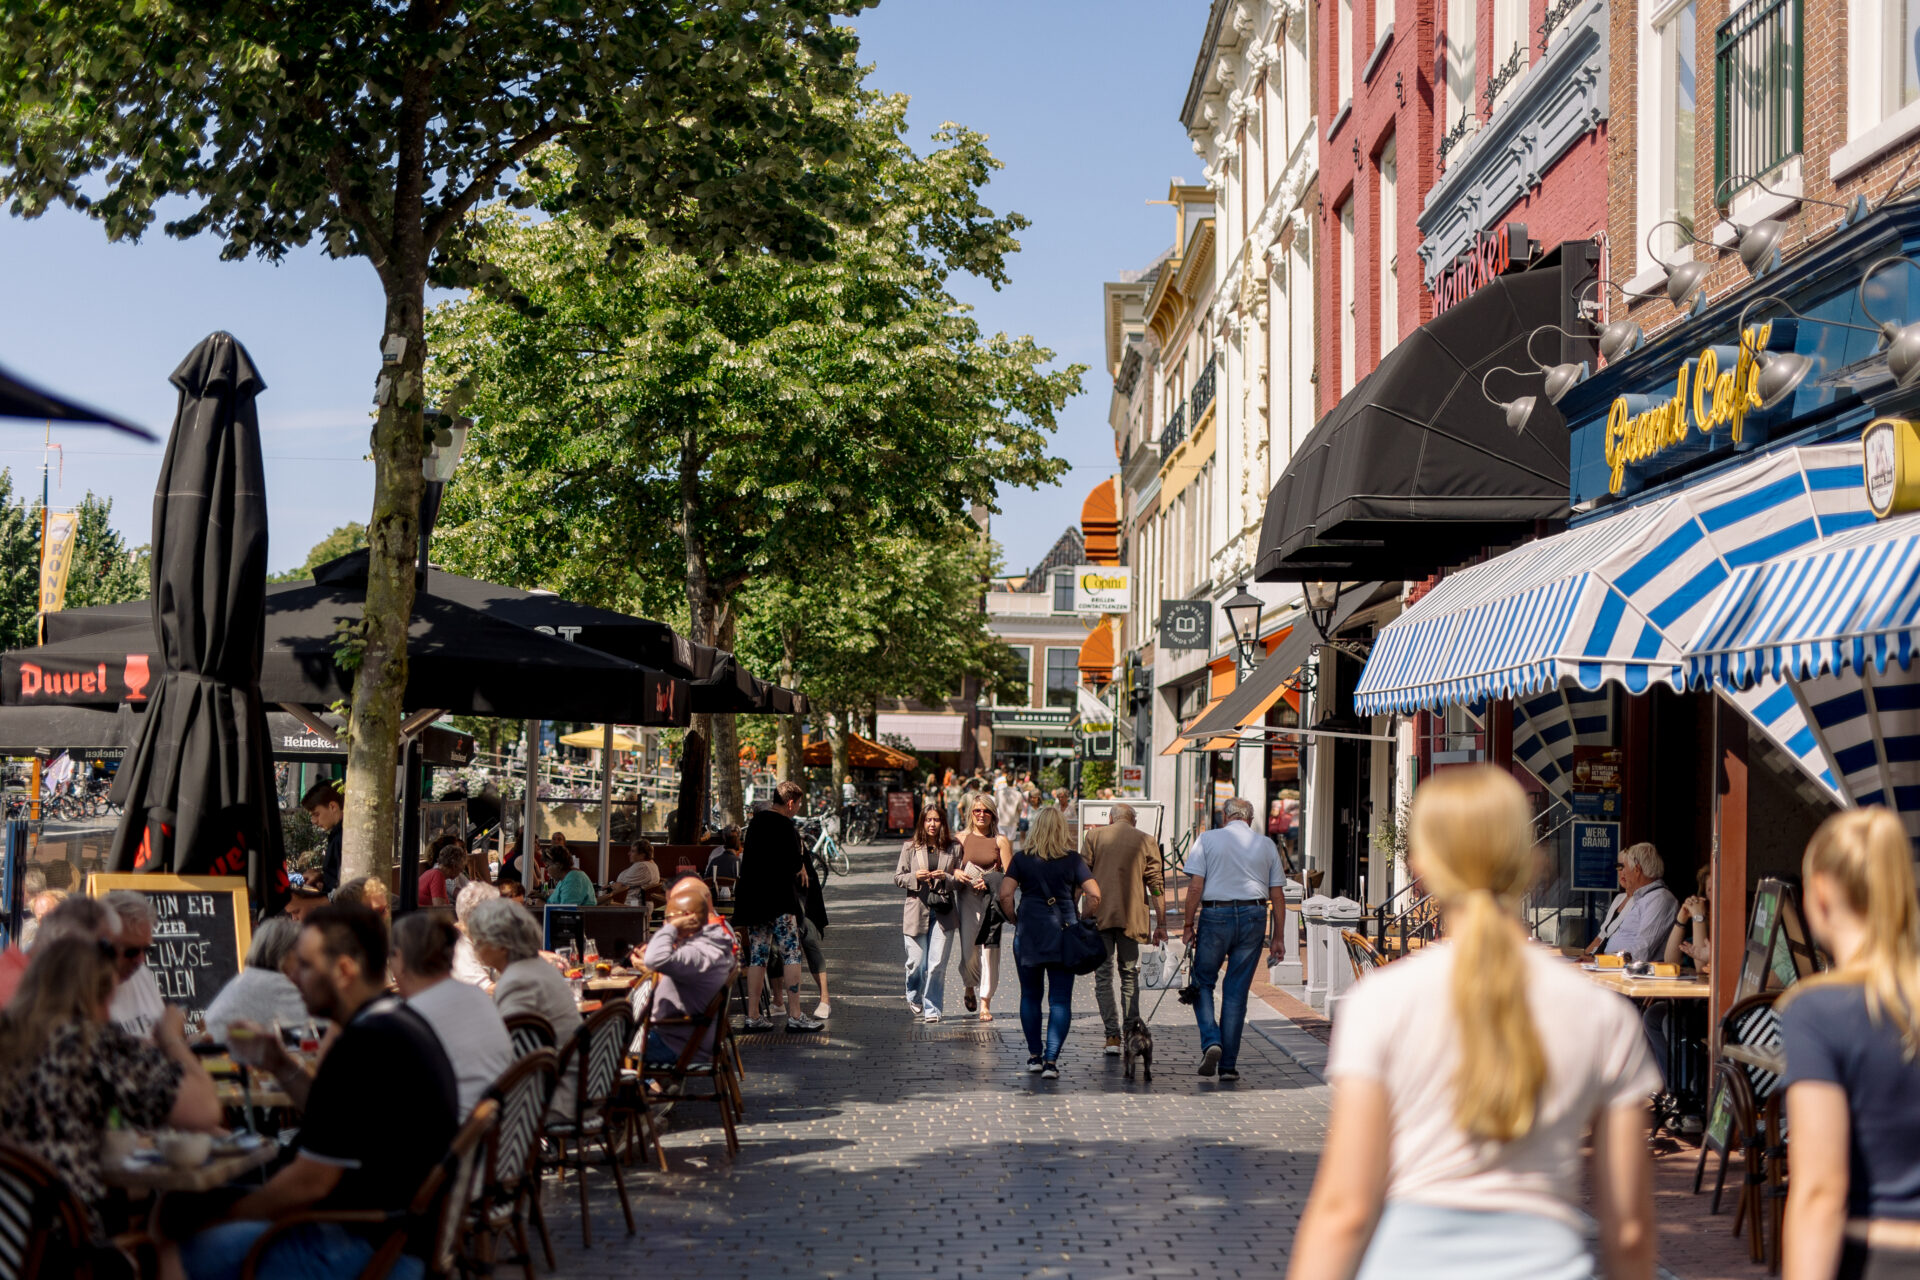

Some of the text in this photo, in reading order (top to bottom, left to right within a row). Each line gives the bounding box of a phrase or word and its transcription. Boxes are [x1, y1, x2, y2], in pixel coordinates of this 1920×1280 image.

[1432, 222, 1511, 320] Heineken
[1605, 362, 1690, 495] Grand
[1083, 572, 1121, 596] Copini
[1166, 610, 1176, 625] VAN
[1175, 604, 1189, 613] DER
[20, 662, 108, 696] Duvel
[1582, 837, 1611, 848] GRAND!
[1585, 827, 1608, 838] WERK
[187, 895, 216, 915] ER
[145, 941, 213, 968] EUWSE
[153, 969, 197, 998] ELEN
